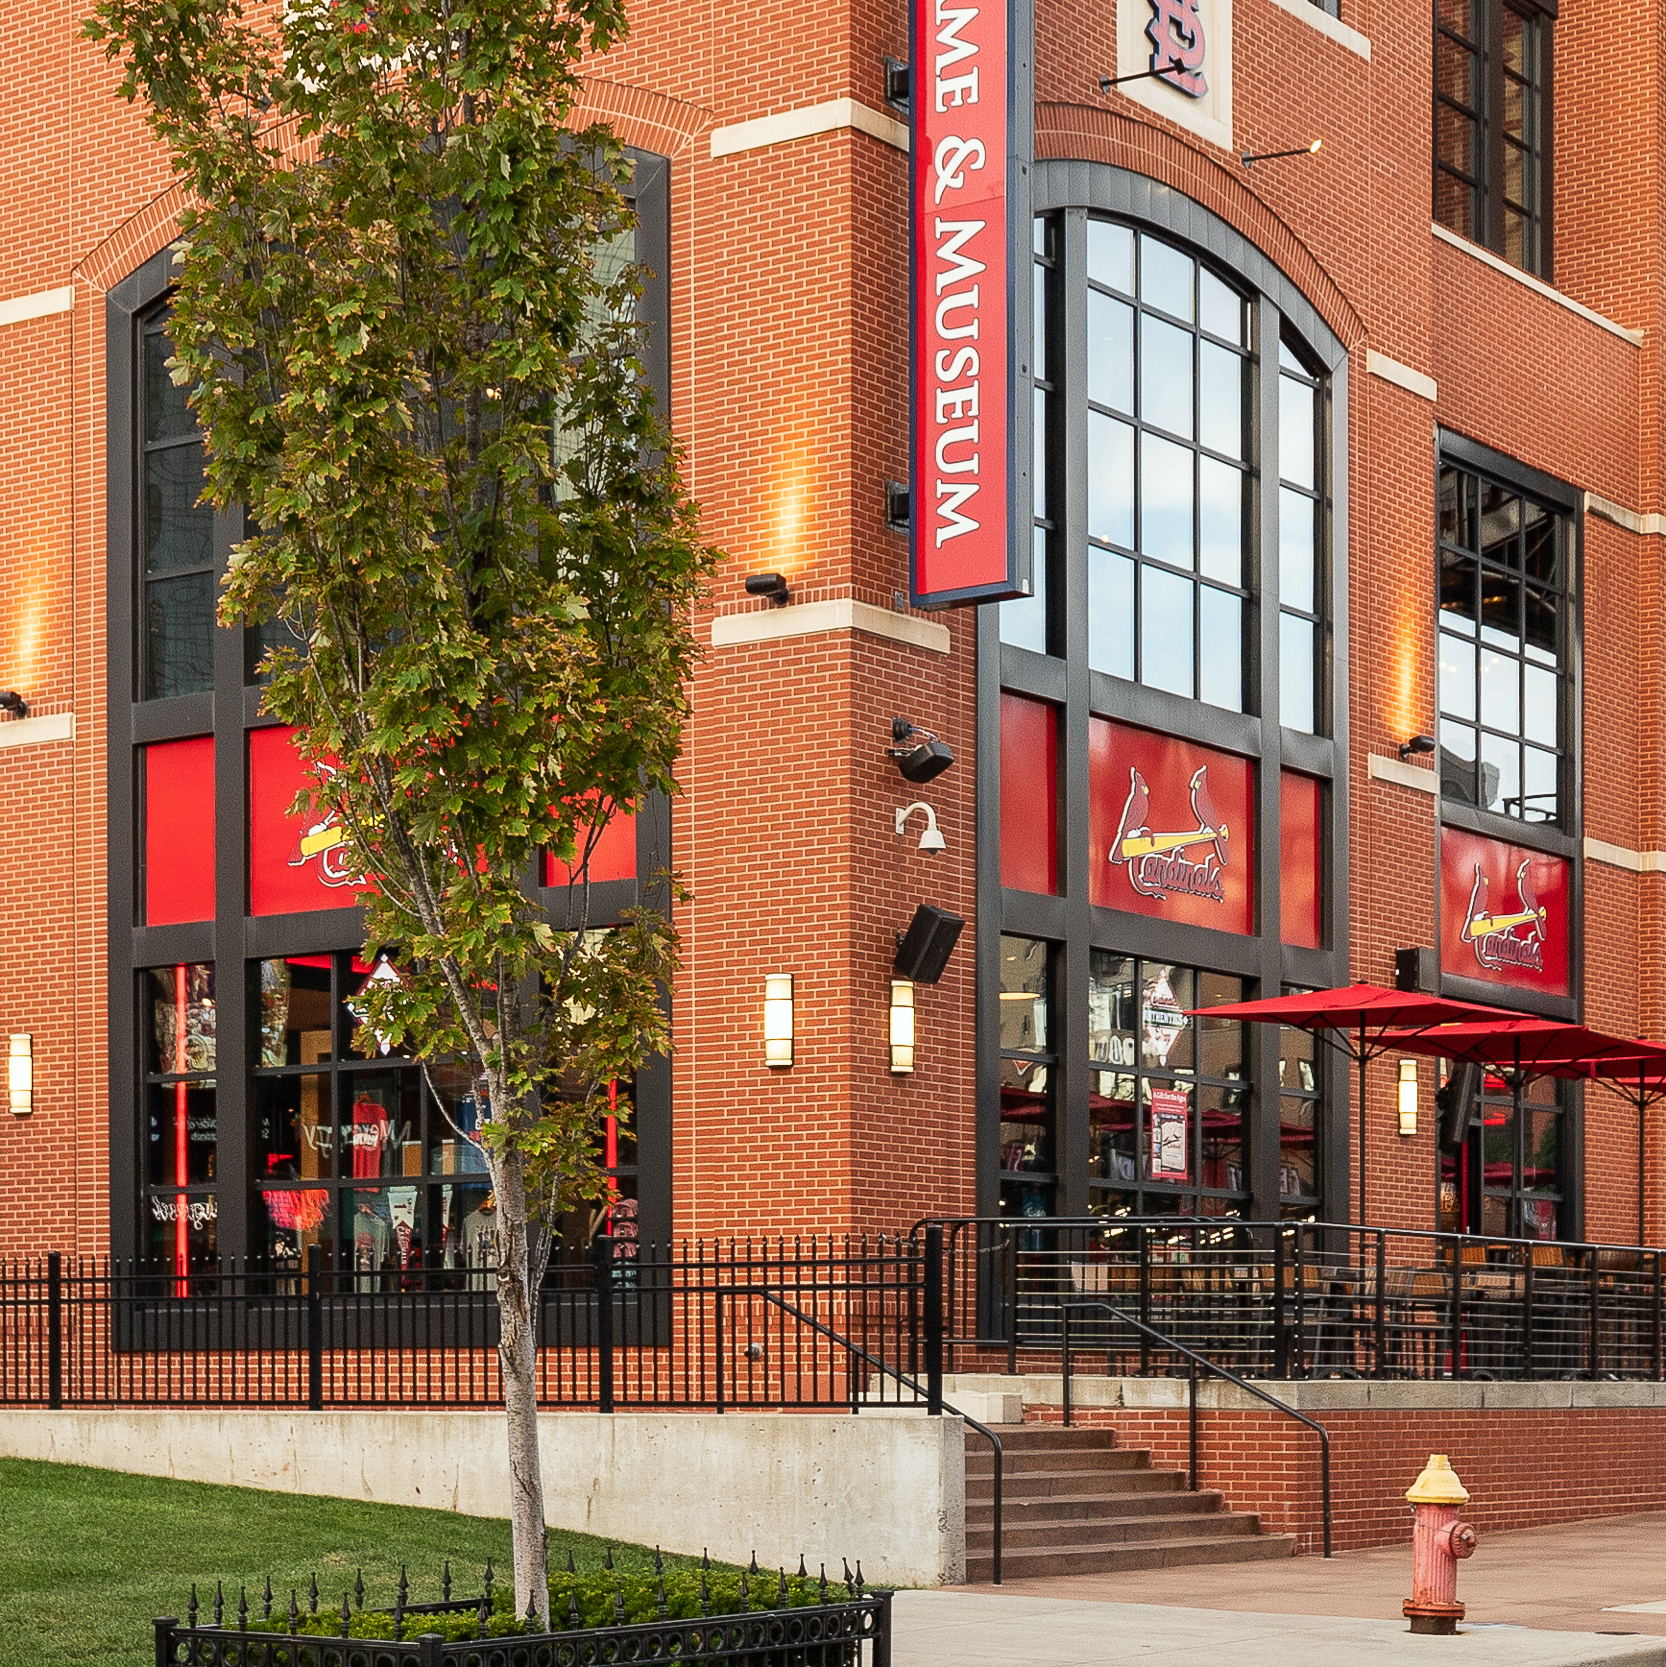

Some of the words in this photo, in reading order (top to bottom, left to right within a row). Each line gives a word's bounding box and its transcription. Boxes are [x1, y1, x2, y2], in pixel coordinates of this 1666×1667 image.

[934, 135, 985, 198] &
[934, 214, 983, 549] MUSEUM
[1129, 847, 1225, 903] Cardinals
